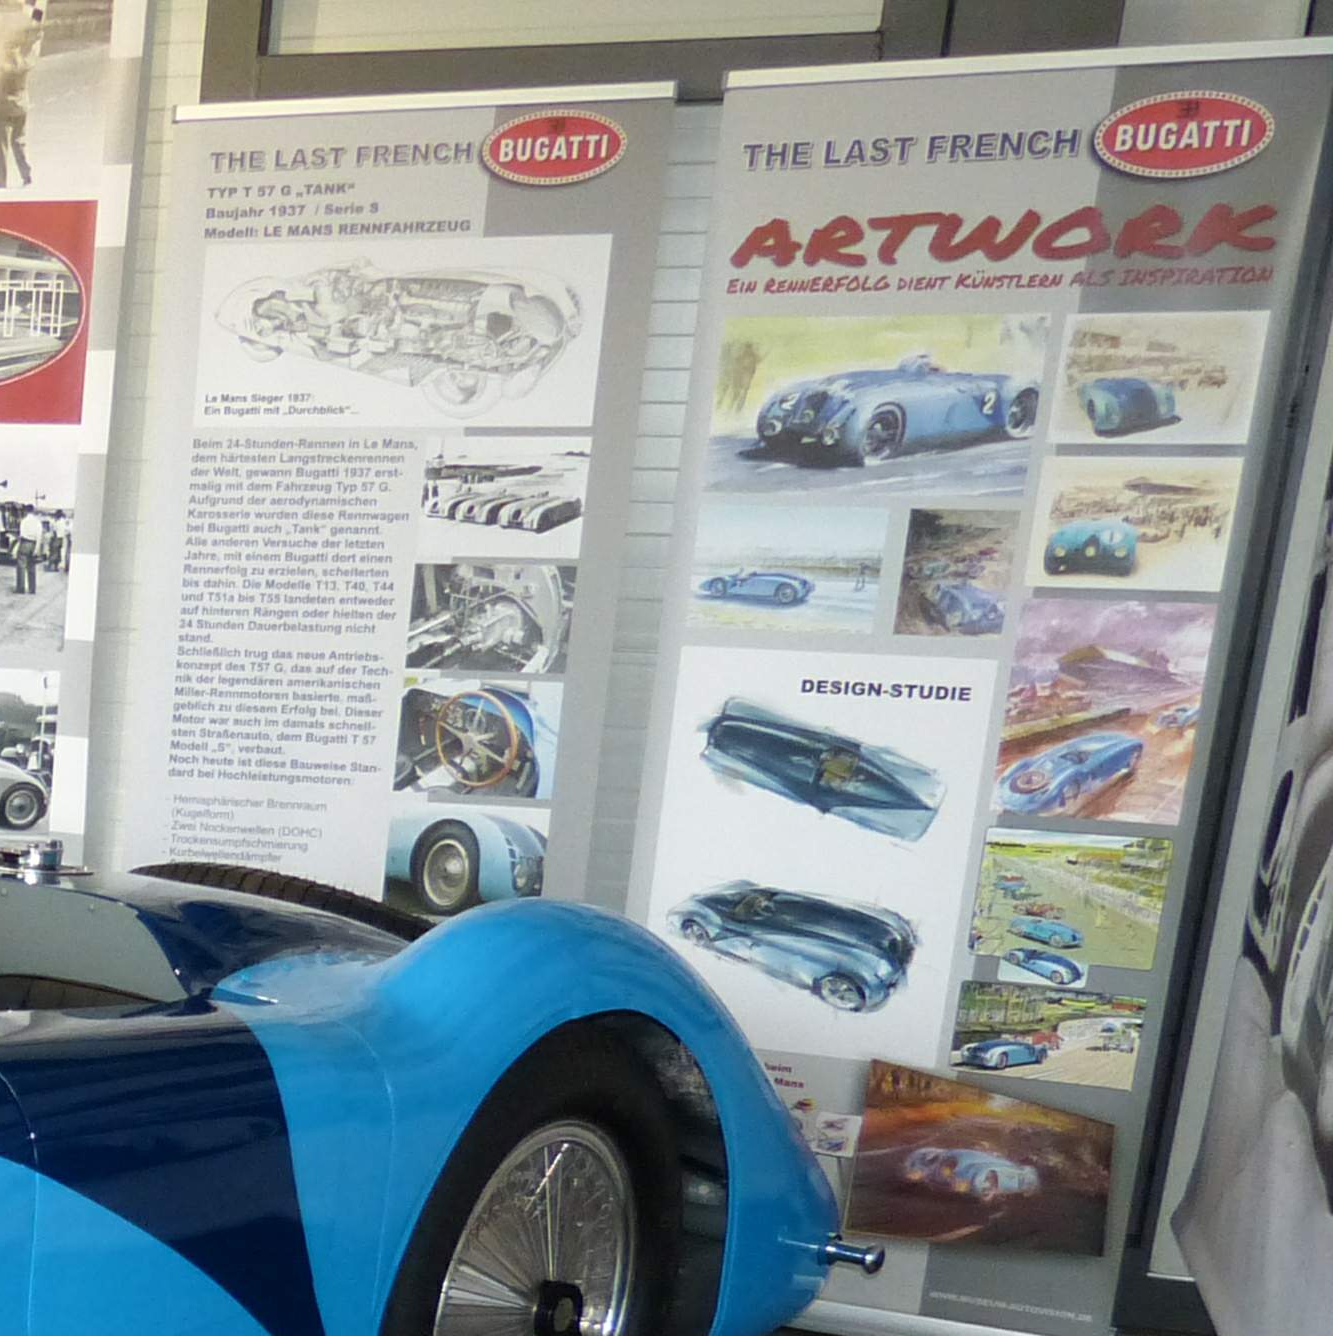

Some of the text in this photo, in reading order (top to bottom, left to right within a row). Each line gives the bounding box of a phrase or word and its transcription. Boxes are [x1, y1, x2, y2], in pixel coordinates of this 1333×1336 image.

[1114, 118, 1254, 153] BUGATTI
[211, 141, 475, 174] THE LAST FRENCH
[498, 133, 611, 163] BUGATTI
[744, 127, 1081, 171] THE LAST FRENCH
[207, 187, 238, 200] TYP
[243, 187, 252, 199] T
[257, 185, 276, 197] 57
[280, 185, 291, 197] G
[206, 206, 264, 222] Baujahr
[269, 204, 306, 218] 1937
[324, 203, 364, 217] Serie
[204, 219, 472, 240] Modell: LE MANS RENNFAHRZEUG
[730, 202, 1278, 269] ARTWORK
[896, 275, 952, 292] DIENT
[1070, 269, 1114, 288] ALS
[1118, 266, 1275, 288] INSPIRATION
[204, 406, 221, 416] Ein
[224, 406, 261, 418] Bugatti
[264, 406, 280, 415] mit
[982, 391, 997, 414] 2
[193, 439, 223, 449] Beim
[348, 439, 360, 449] in
[364, 439, 378, 450] Le
[191, 467, 210, 477] der
[246, 469, 292, 480] gewann
[296, 467, 339, 480] Bugatti
[344, 467, 371, 478] 1937
[246, 481, 272, 491] dem
[276, 481, 332, 495] Fahrzeug
[335, 482, 357, 495] Typ
[799, 677, 972, 703] DESIGN-STUDIE
